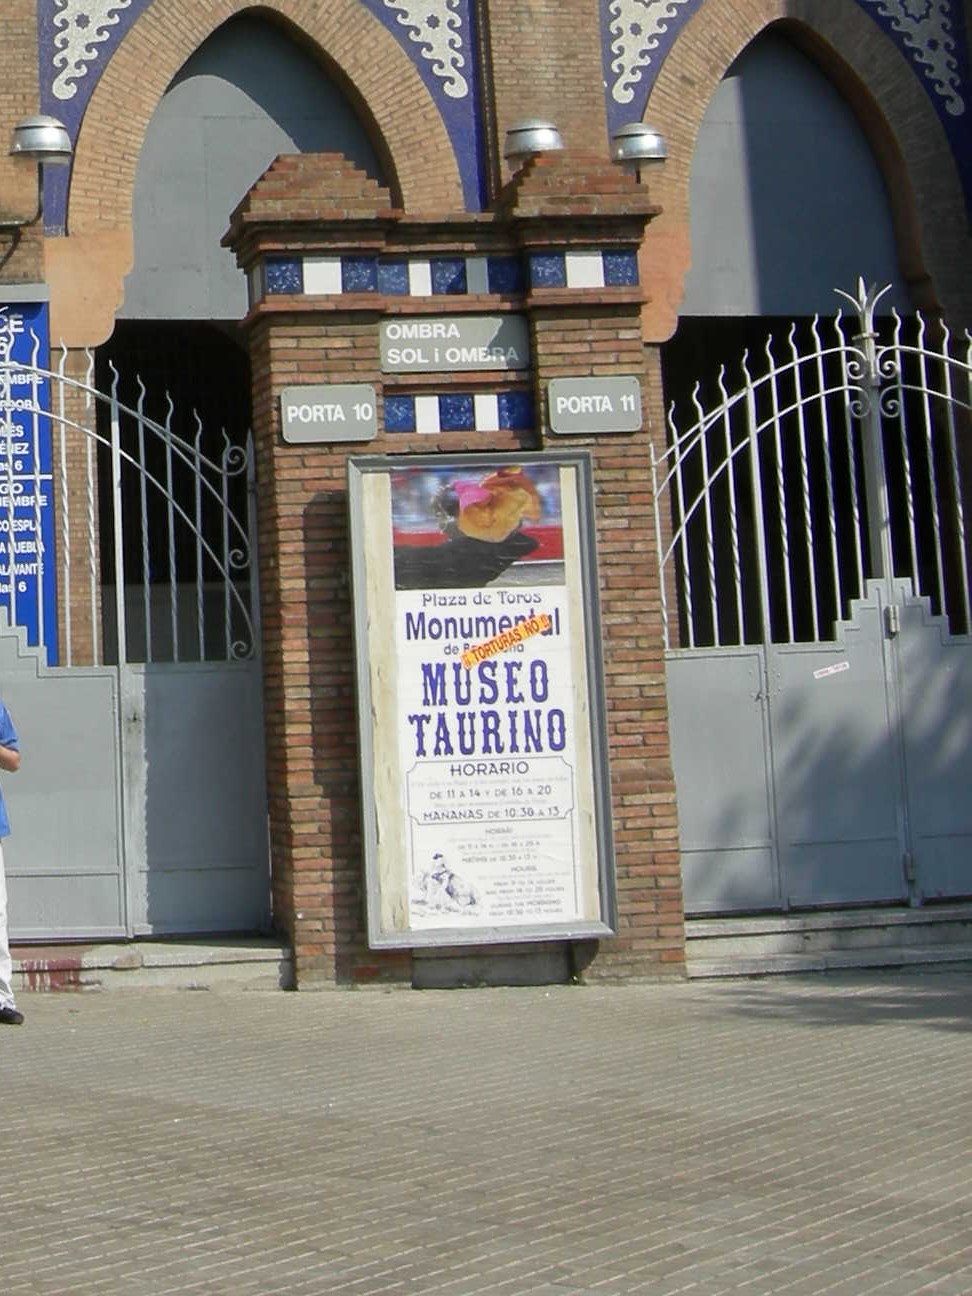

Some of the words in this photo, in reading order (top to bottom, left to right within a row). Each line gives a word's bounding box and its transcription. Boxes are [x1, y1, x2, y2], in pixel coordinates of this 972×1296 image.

[386, 323, 460, 340] OMBRA
[388, 348, 428, 365] SOL
[434, 349, 440, 364] i
[446, 346, 518, 363] OMBRA
[556, 395, 612, 414] PORTA
[619, 394, 635, 412] 11
[287, 404, 345, 423] PORTA
[353, 403, 372, 422] 10
[14, 459, 24, 471] 6
[12, 518, 41, 532] ESPL
[18, 581, 27, 593] 6
[422, 593, 467, 607] Plaza
[473, 591, 492, 605] de
[497, 590, 542, 604] Toros
[471, 626, 523, 663] TORTURAS
[523, 618, 540, 637] NO
[444, 643, 460, 656] de
[421, 659, 549, 707] MUSEO
[408, 708, 567, 757] TAURINO
[450, 760, 529, 777] HORARIO
[537, 784, 552, 796] 20
